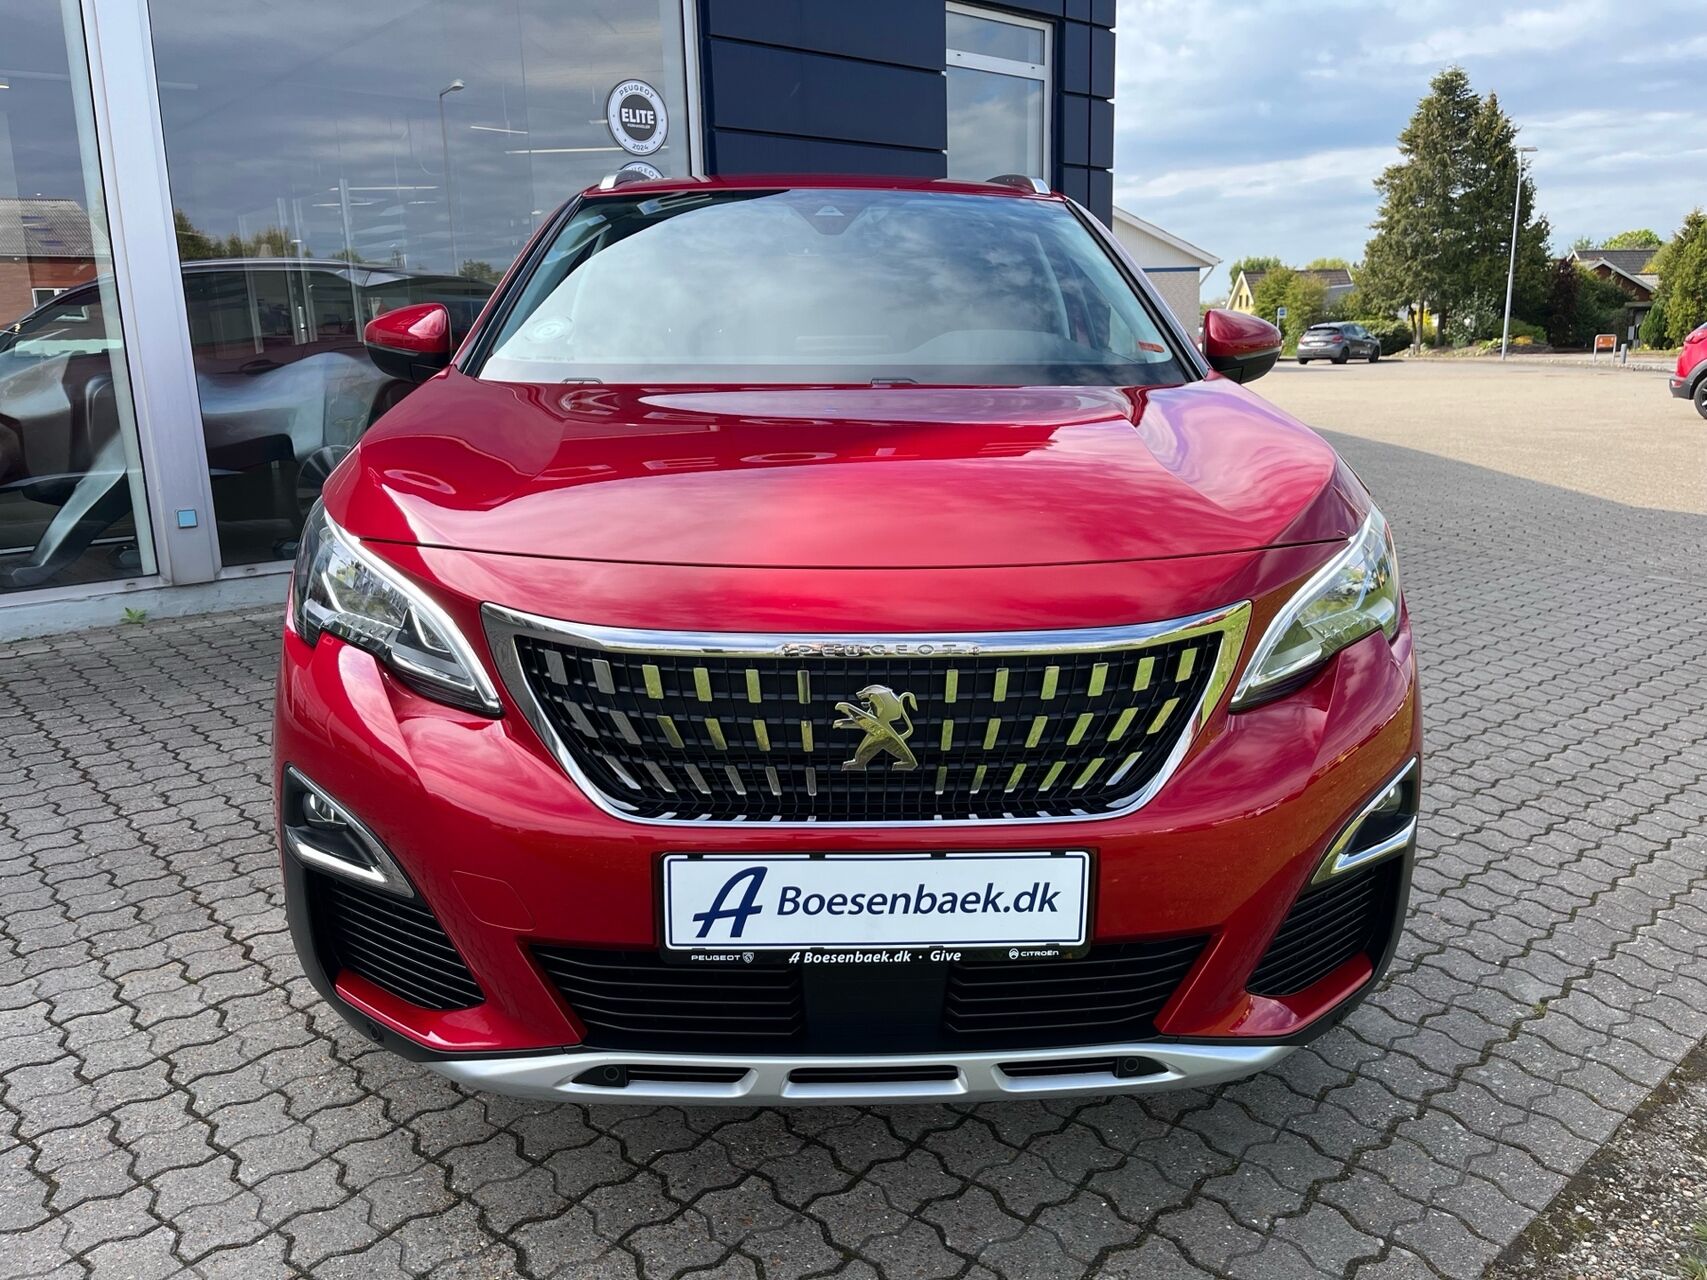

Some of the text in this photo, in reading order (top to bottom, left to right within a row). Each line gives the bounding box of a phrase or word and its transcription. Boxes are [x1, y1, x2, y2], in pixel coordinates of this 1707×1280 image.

[619, 84, 655, 98] PEUGEOT
[621, 107, 655, 125] ELITE
[632, 143, 649, 151] 2024
[795, 644, 957, 656] PEUGEOT
[776, 882, 1061, 916] Boesenbaek.dk
[804, 951, 912, 963] Boesenbaek.dk
[930, 950, 962, 962] Give
